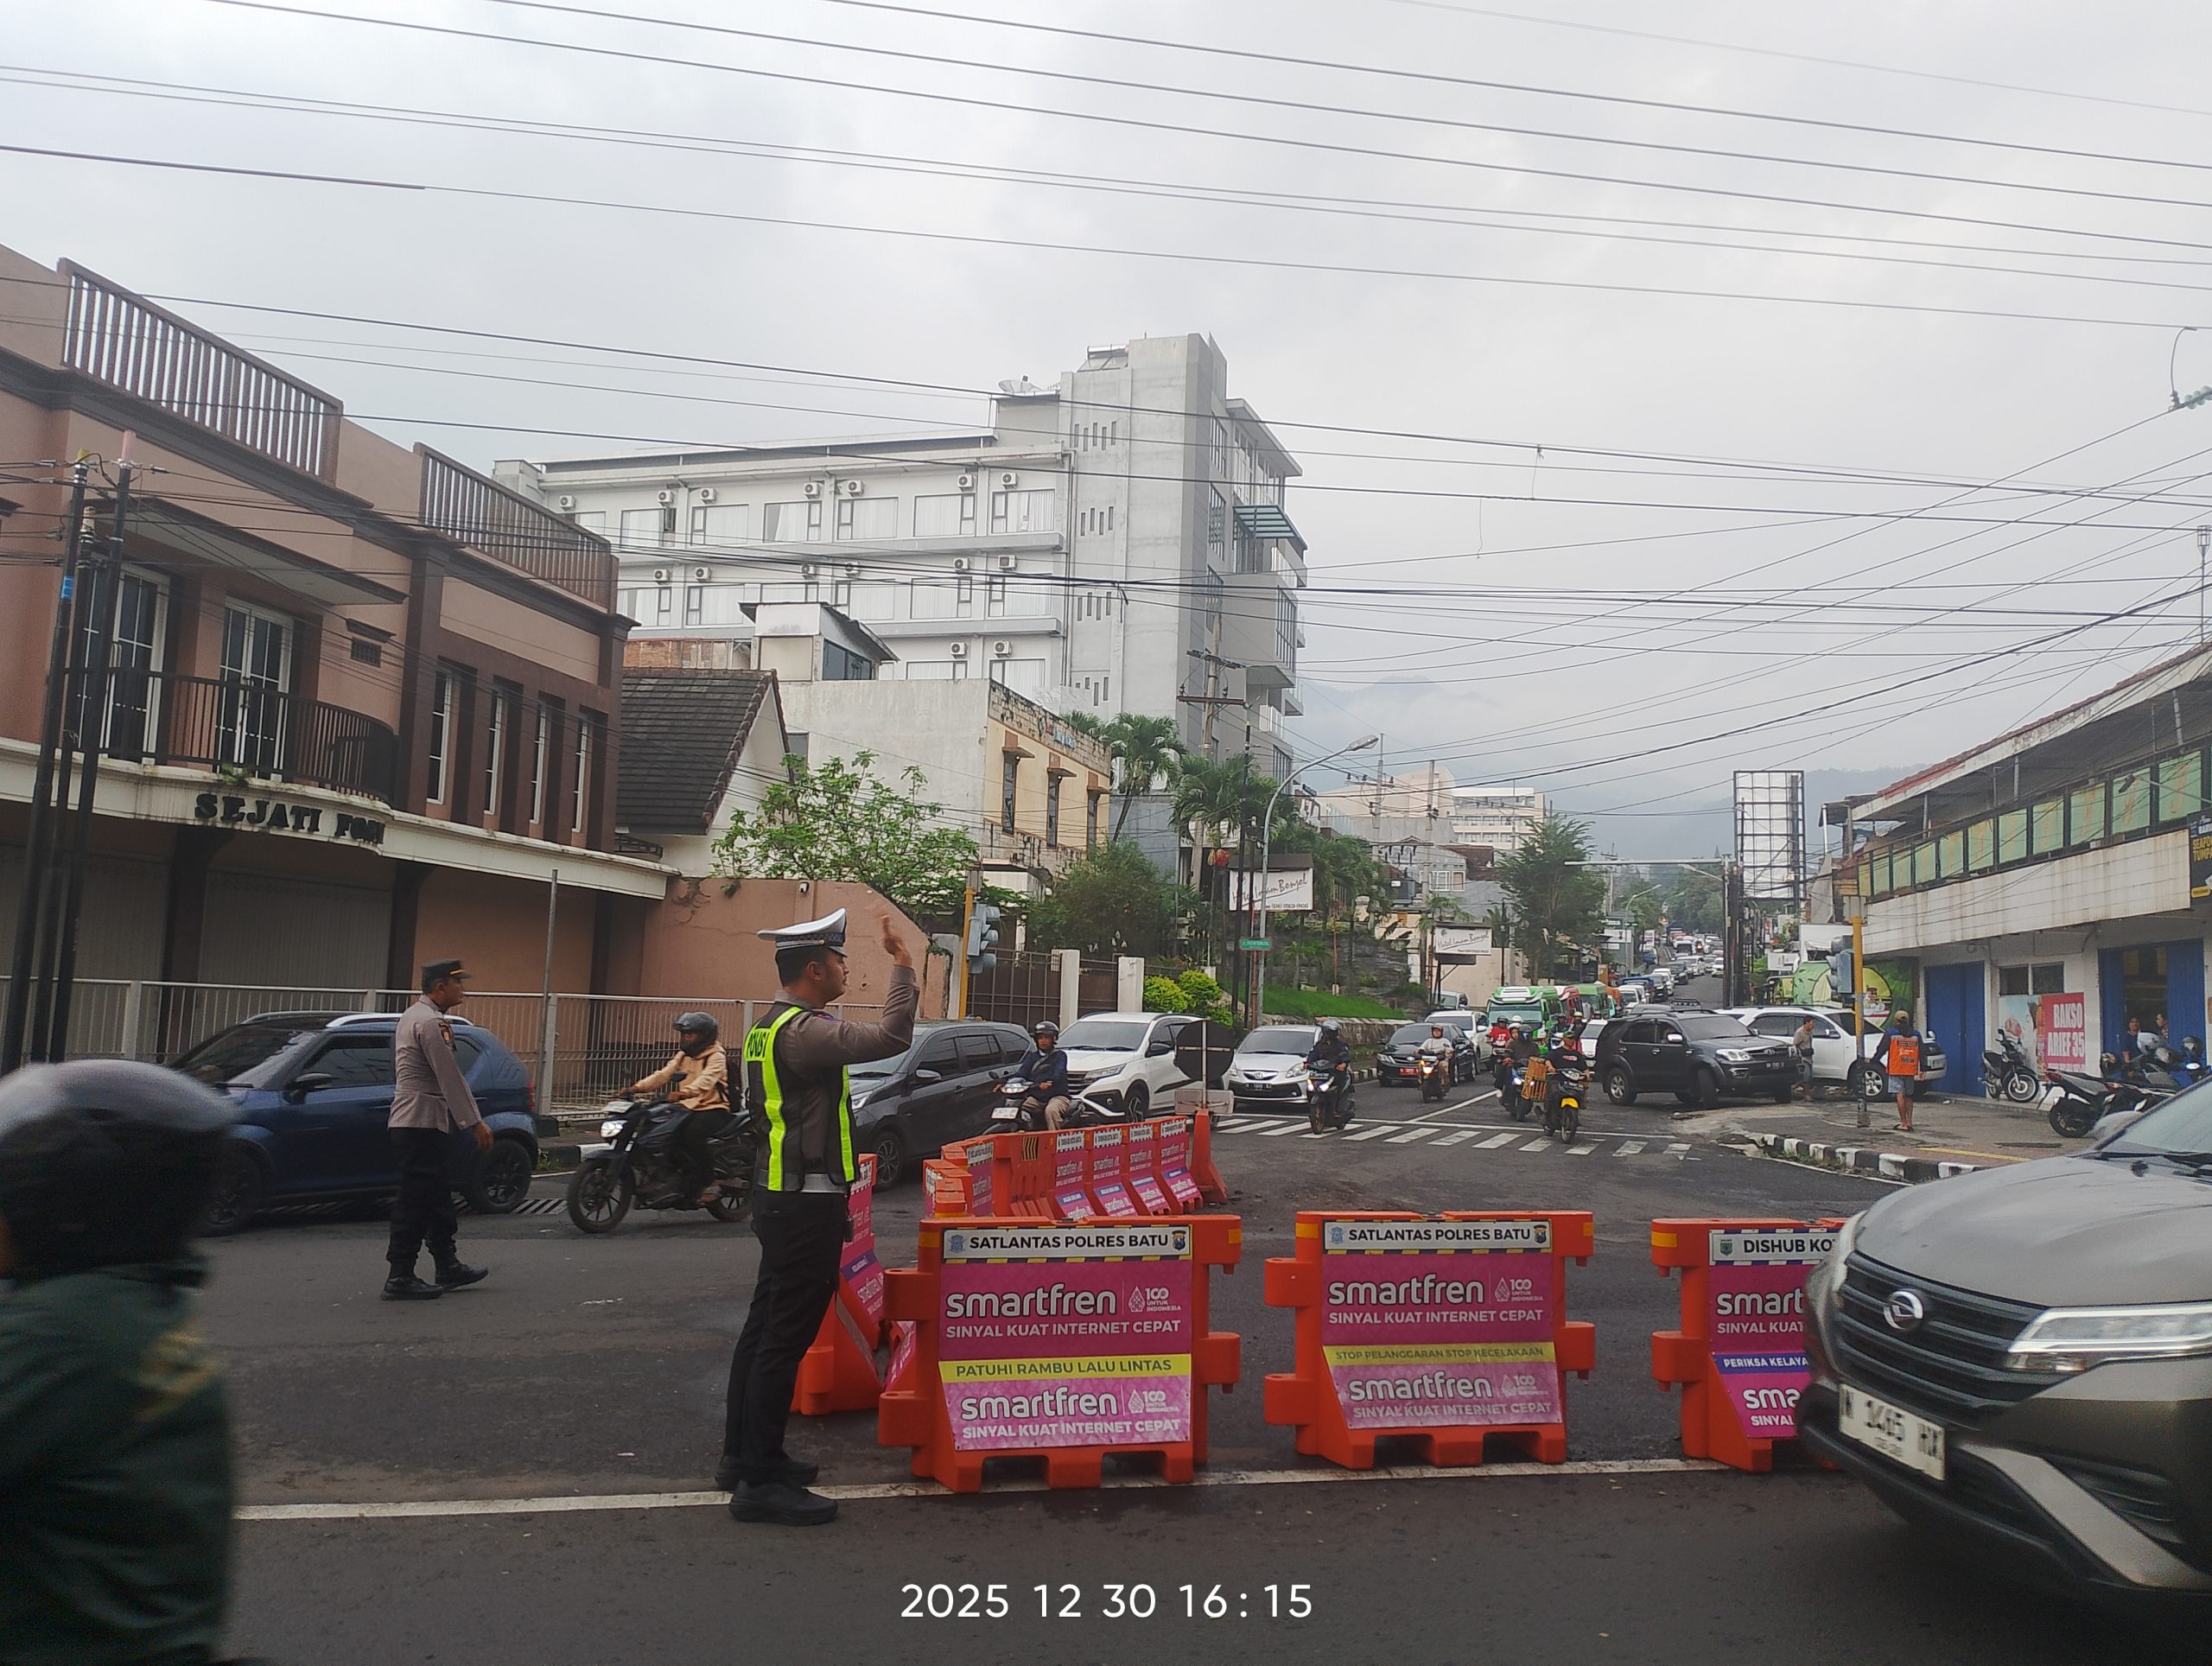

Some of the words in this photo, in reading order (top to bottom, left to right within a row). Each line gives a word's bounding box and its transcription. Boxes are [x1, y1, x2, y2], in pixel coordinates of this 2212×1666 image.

[194, 793, 322, 832] SEJATI
[2053, 1002, 2083, 1028] BAKSO
[2047, 1032, 2072, 1057] ARIEF
[2072, 1032, 2085, 1058] 35
[969, 1236, 1060, 1249] SATLANTAS
[1065, 1234, 1125, 1248] POLRES
[1129, 1233, 1168, 1247] BATU
[1349, 1229, 1432, 1241] SATLANTAS
[1435, 1229, 1491, 1241] POLRES
[1494, 1228, 1530, 1240] BATU
[1744, 1239, 1806, 1253] DISHUB
[1809, 1238, 1836, 1252] KO
[1328, 1274, 1484, 1305] smartfren
[946, 1283, 1116, 1317] smartfren
[1328, 1312, 1382, 1325] SINYAL
[1384, 1311, 1422, 1324] KUAT
[1426, 1310, 1497, 1323] INTERNET
[1499, 1310, 1543, 1321] CEPAT
[946, 1325, 1003, 1339] SINYAL
[1007, 1323, 1048, 1337] KUAT
[1052, 1321, 1129, 1336] INTERNET
[1133, 1319, 1180, 1333] CEPAT
[1717, 1321, 1766, 1334] SINYAL
[1770, 1321, 1804, 1333] KUAT
[1335, 1351, 1363, 1359] STOP
[1365, 1349, 1443, 1359] PELANGGARAN
[1446, 1348, 1471, 1358] STOP
[1473, 1347, 1543, 1358] KECELAKAAN
[957, 1364, 1013, 1377] PATUHI
[1017, 1362, 1074, 1376] RAMBU
[1078, 1361, 1116, 1374] LALU
[1120, 1359, 1172, 1372] LINTAS
[1724, 1358, 1768, 1368] PERIKSA
[1348, 1370, 1493, 1402] smartfren
[961, 1386, 1118, 1421] smartfren
[1353, 1407, 1402, 1419] SINYAL
[1405, 1405, 1440, 1417] KUAT
[1443, 1403, 1508, 1416] INTERNET
[1510, 1402, 1551, 1415] CEPAT
[963, 1425, 1015, 1440] SINYAL
[1020, 1422, 1058, 1436] KUAT
[1061, 1420, 1131, 1434] INTERNET
[1135, 1419, 1180, 1432] CEPAT
